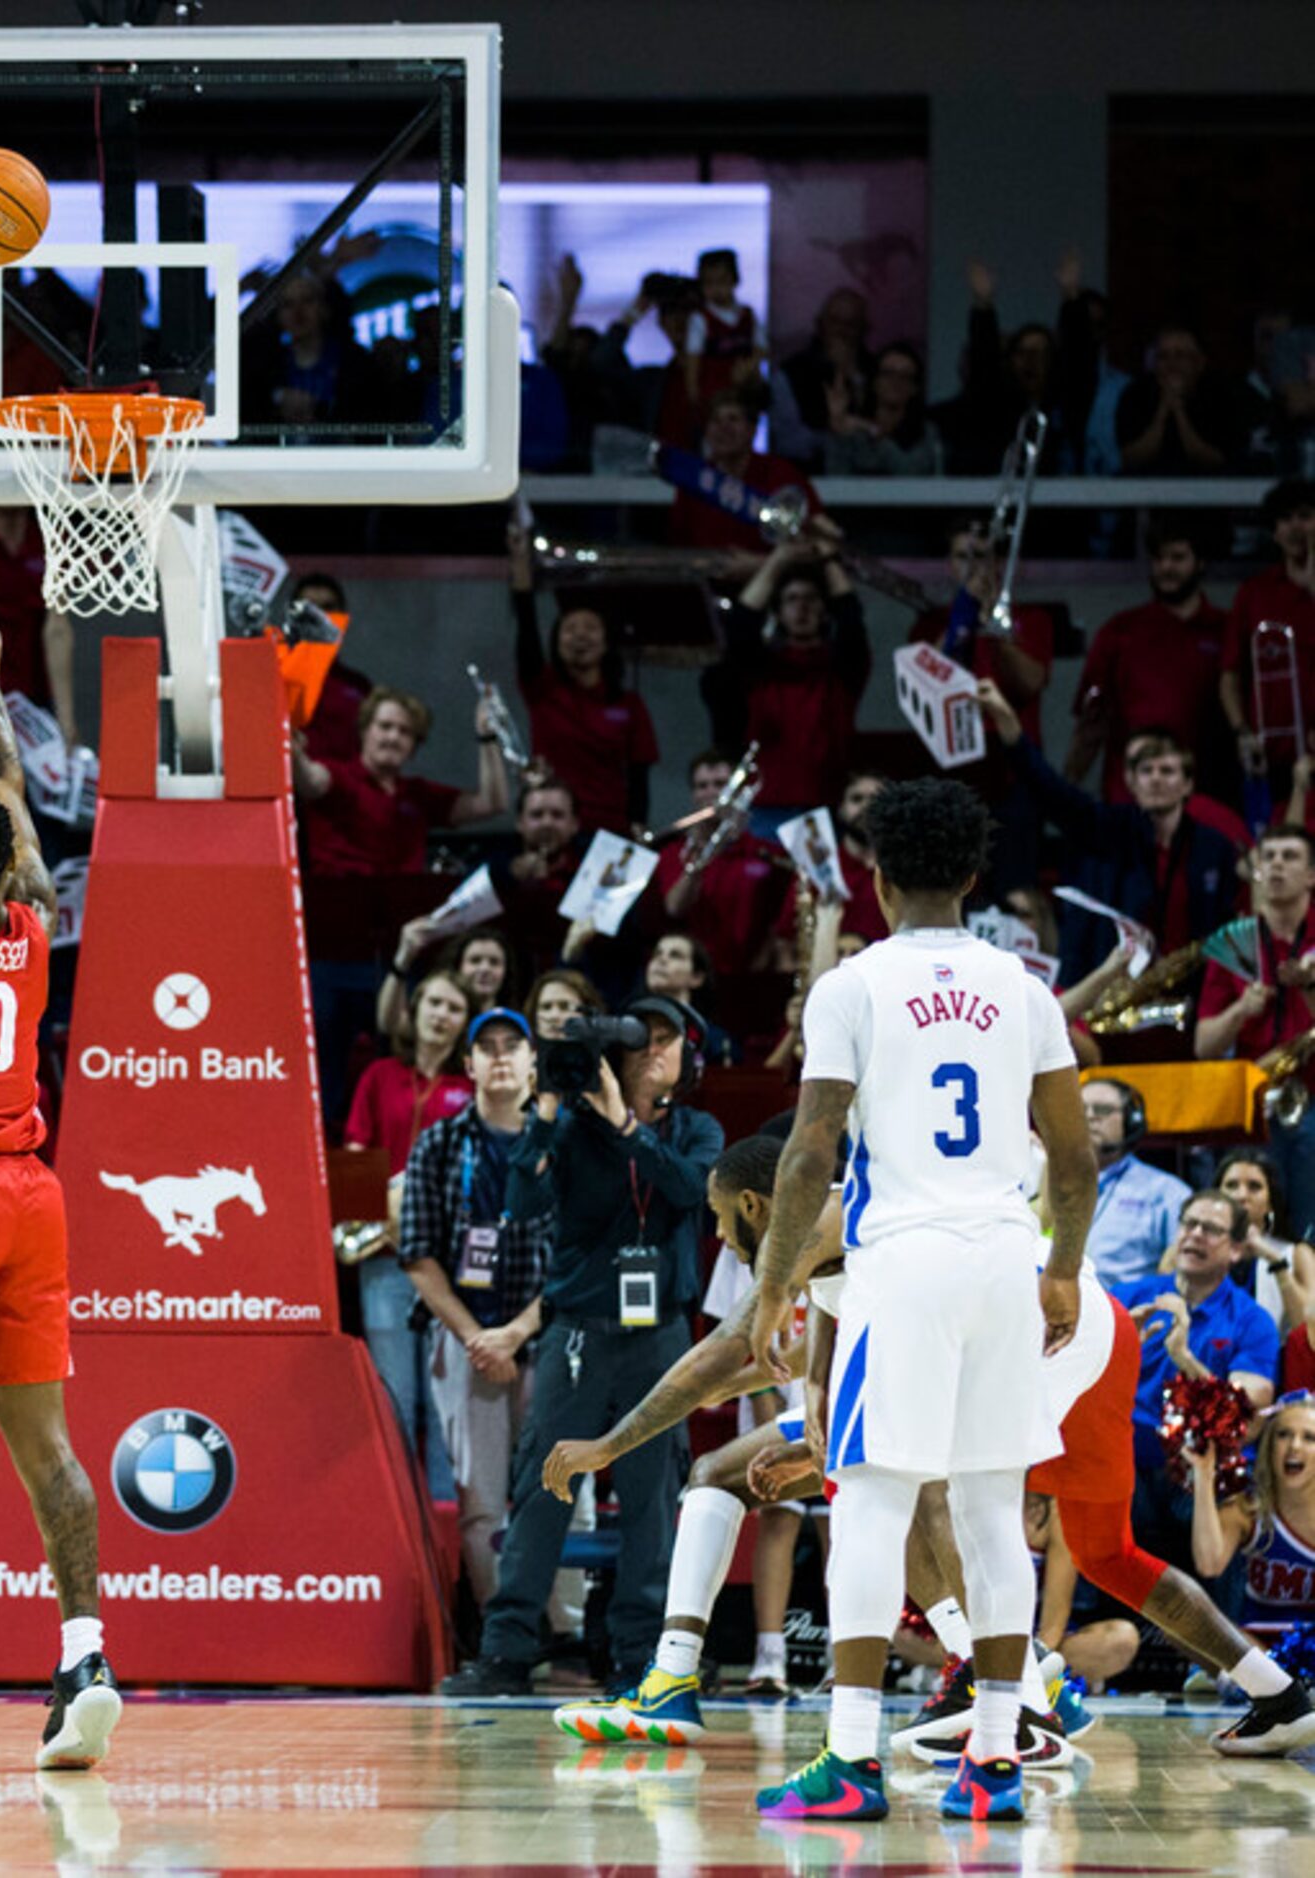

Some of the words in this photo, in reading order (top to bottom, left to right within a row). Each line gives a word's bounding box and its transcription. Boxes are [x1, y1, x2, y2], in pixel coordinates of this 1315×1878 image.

[906, 990, 1000, 1032] DAVIS
[79, 1045, 189, 1088] Origin
[200, 1046, 286, 1080] Bank
[931, 1062, 981, 1157] 3
[69, 1289, 321, 1321] cketSmarter.com
[127, 1413, 226, 1451] BMW
[1246, 1555, 1315, 1605] SM
